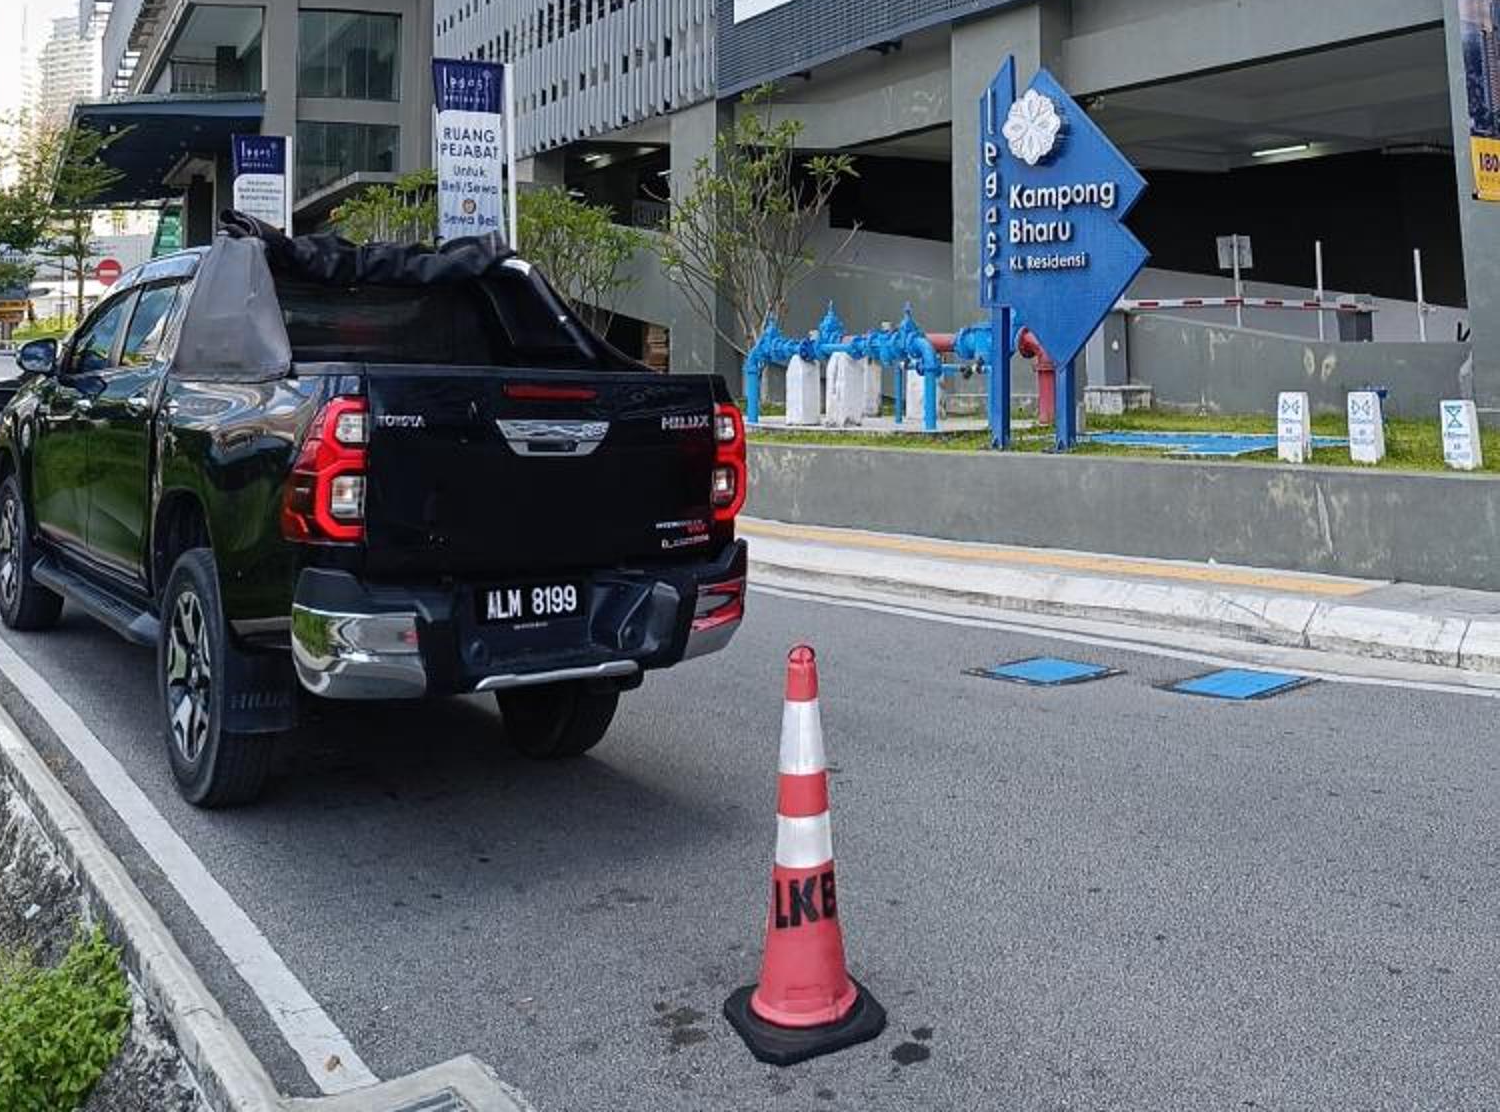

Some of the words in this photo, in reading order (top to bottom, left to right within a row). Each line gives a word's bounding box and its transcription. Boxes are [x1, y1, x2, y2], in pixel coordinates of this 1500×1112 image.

[443, 127, 495, 143] RUANG
[440, 143, 499, 160] PEJABAT
[1010, 181, 1115, 210] Kampong
[1010, 218, 1071, 243] Bharu
[1010, 256, 1023, 270] KL
[1028, 252, 1086, 269] Residensi
[377, 415, 425, 427] TOYOTA
[661, 415, 709, 430] HILUX
[532, 584, 577, 615] 8199
